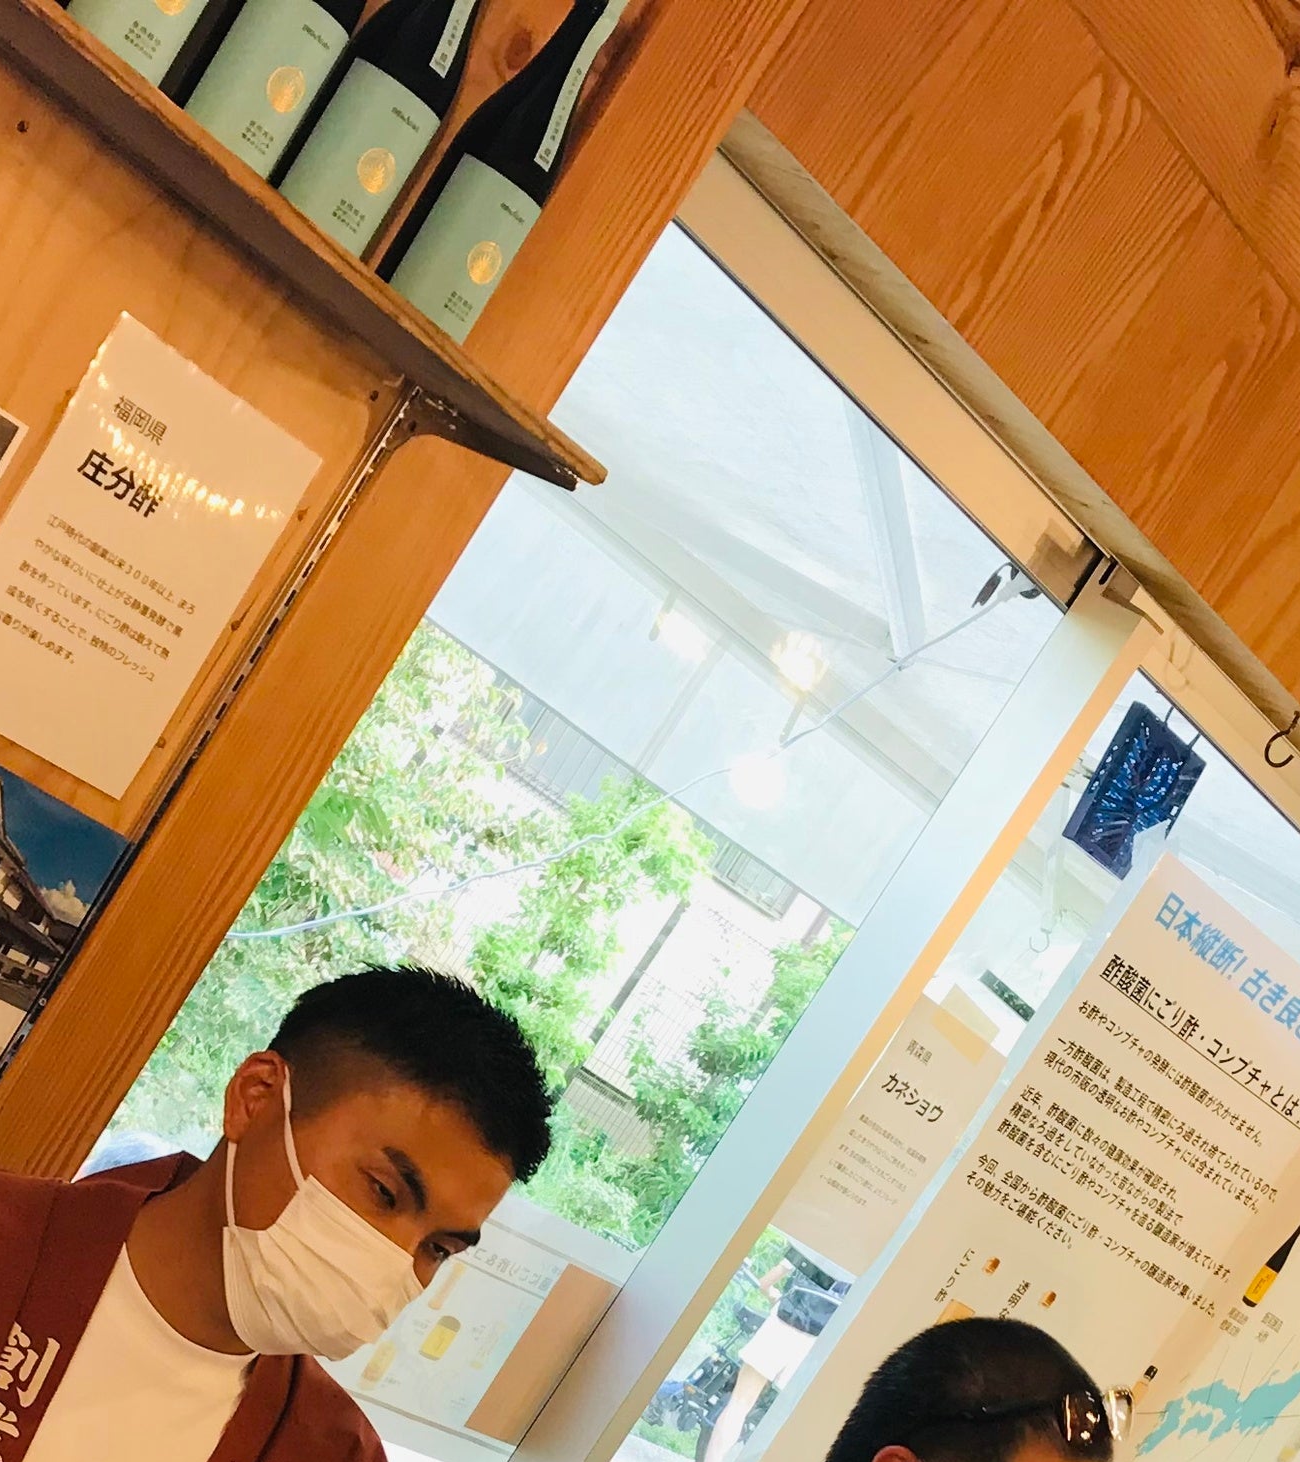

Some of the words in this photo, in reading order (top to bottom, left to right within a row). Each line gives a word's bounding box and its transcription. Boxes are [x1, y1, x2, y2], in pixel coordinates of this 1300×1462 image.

[109, 394, 170, 446] 福岡県
[75, 444, 164, 521] 庄分酢
[880, 1070, 945, 1125] カネショウ
[964, 1169, 1077, 1251] その魅力をご堪能ください。
[934, 1248, 975, 1303] にごり酢
